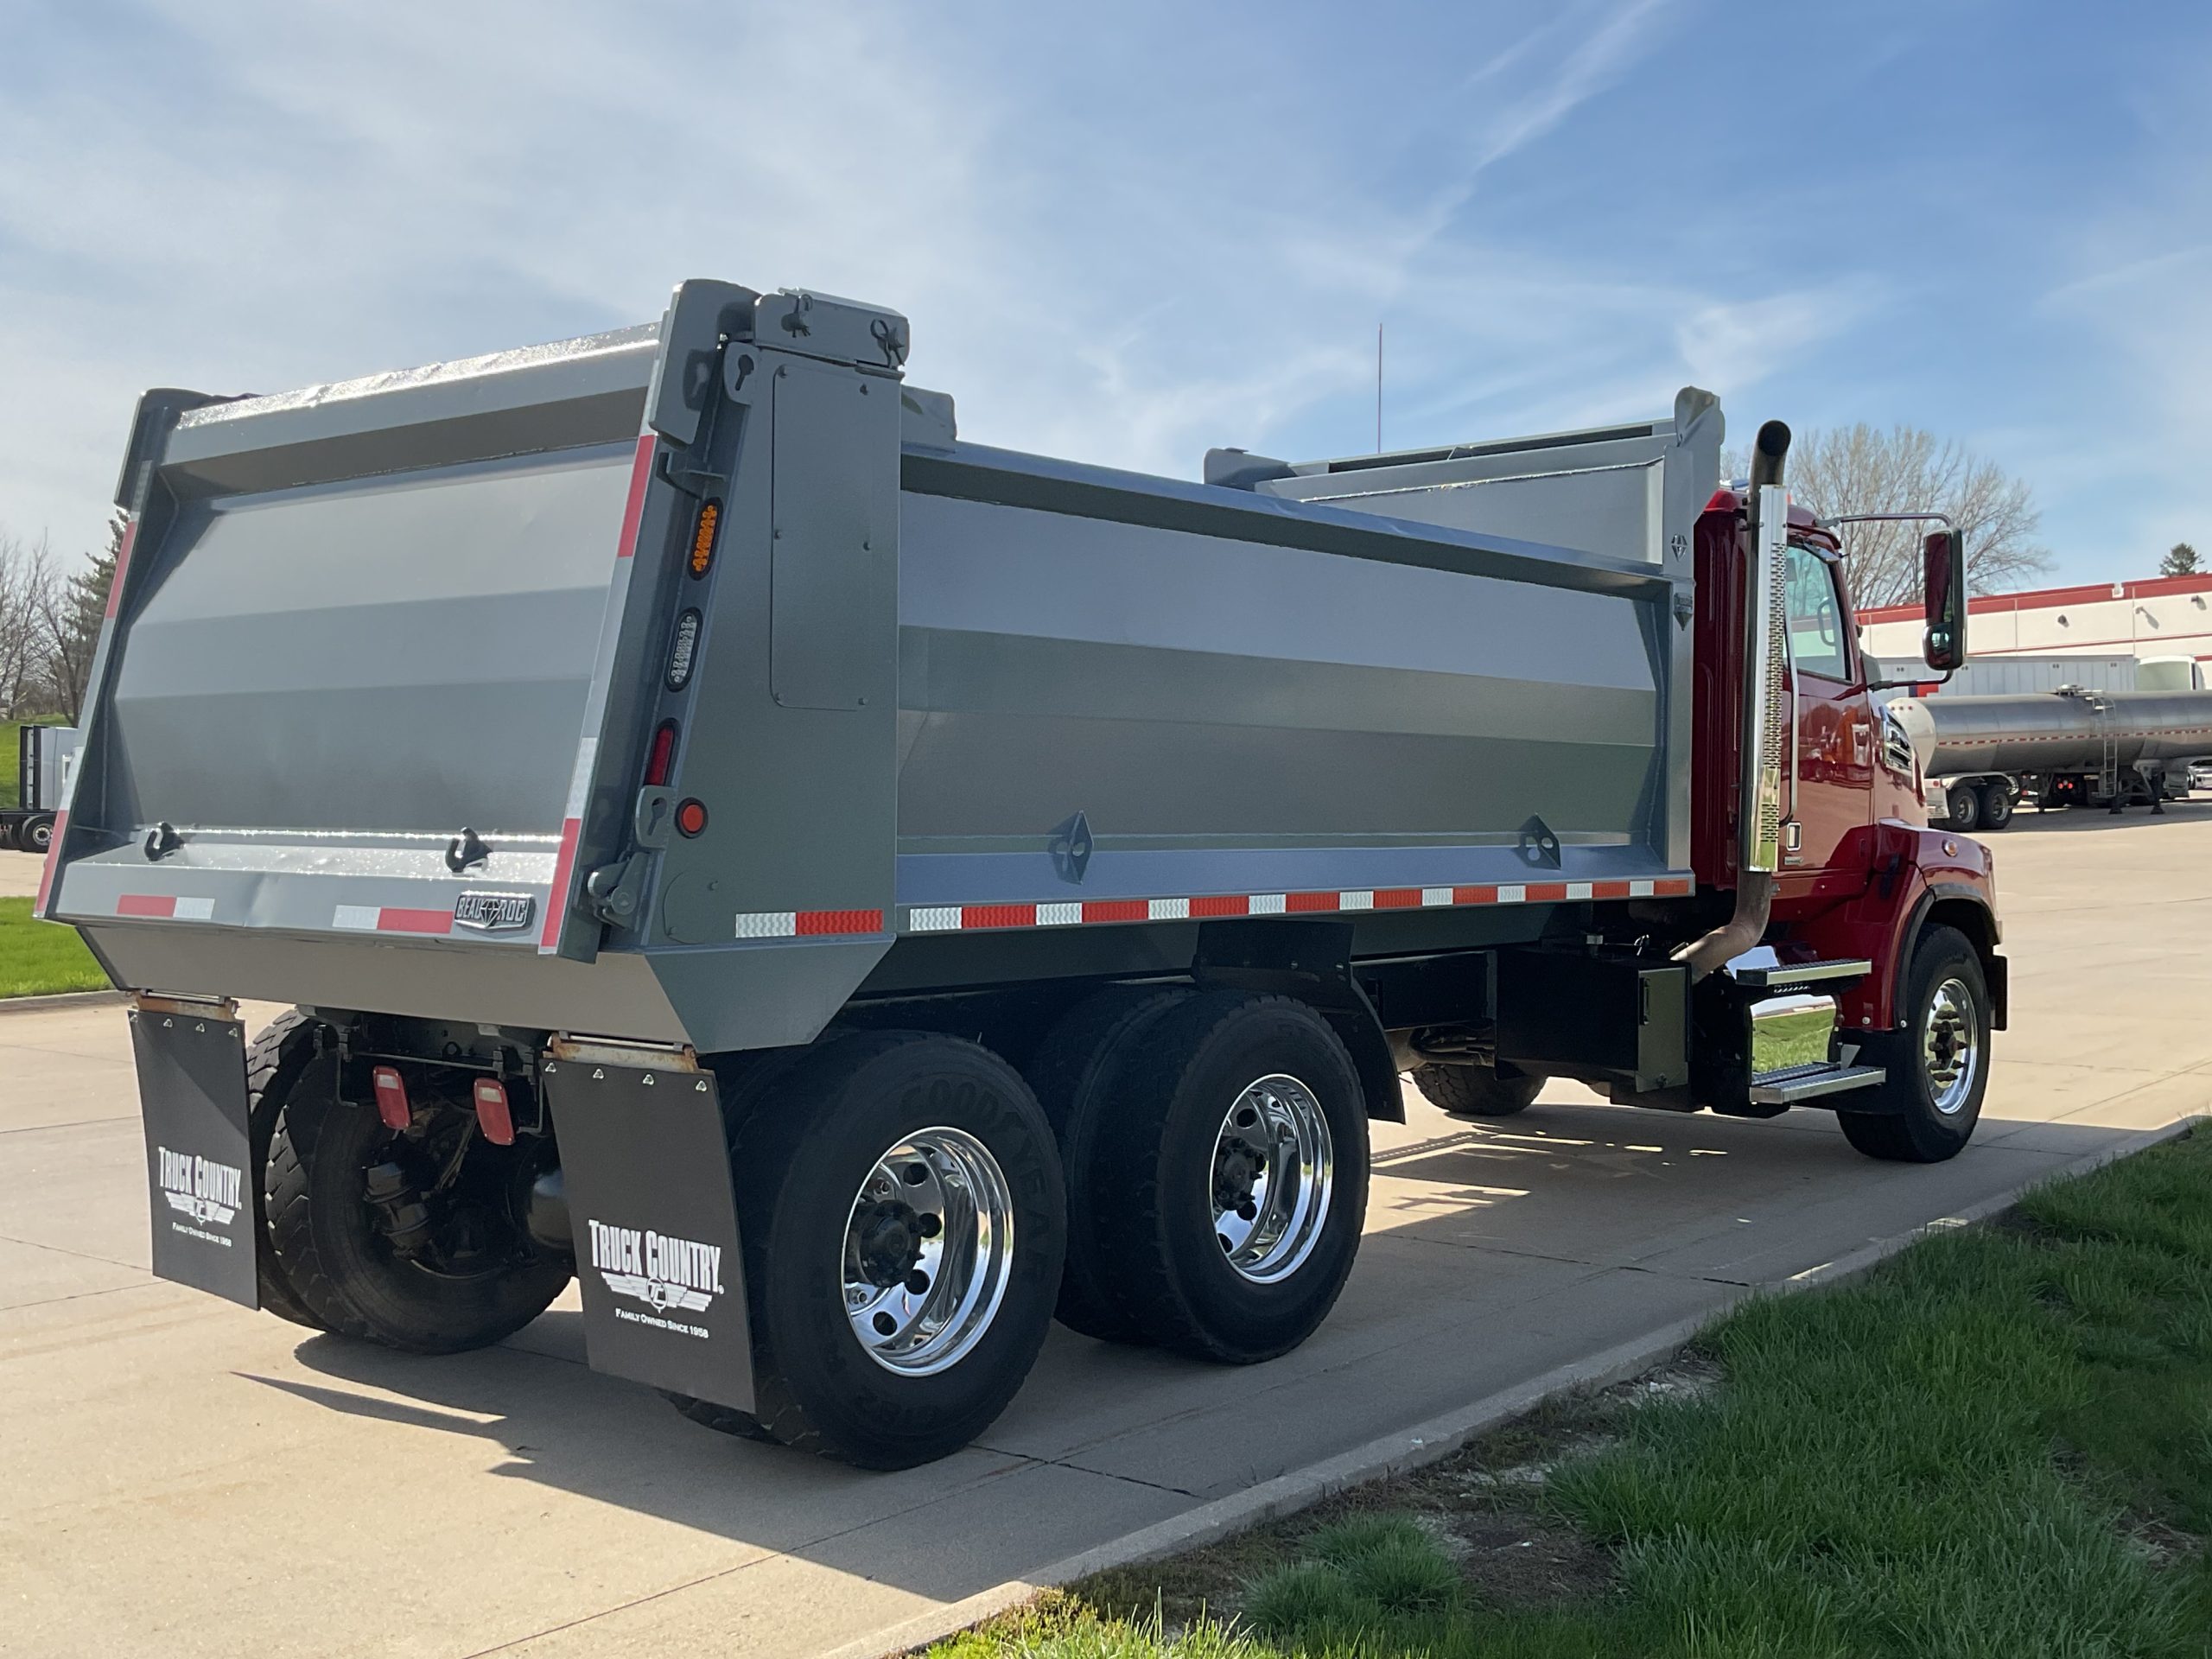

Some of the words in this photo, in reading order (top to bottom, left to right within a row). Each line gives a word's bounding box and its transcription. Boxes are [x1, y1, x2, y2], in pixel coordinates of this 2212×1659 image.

[158, 1146, 193, 1194] TRUCK
[194, 1155, 241, 1208] COUNTRY
[588, 1219, 642, 1275] TRUCK
[645, 1230, 721, 1293] COUNTRY
[615, 1307, 640, 1322] FAMILY
[641, 1313, 667, 1328] OWNED
[667, 1319, 689, 1333] SINCE
[690, 1325, 709, 1338] 1958
